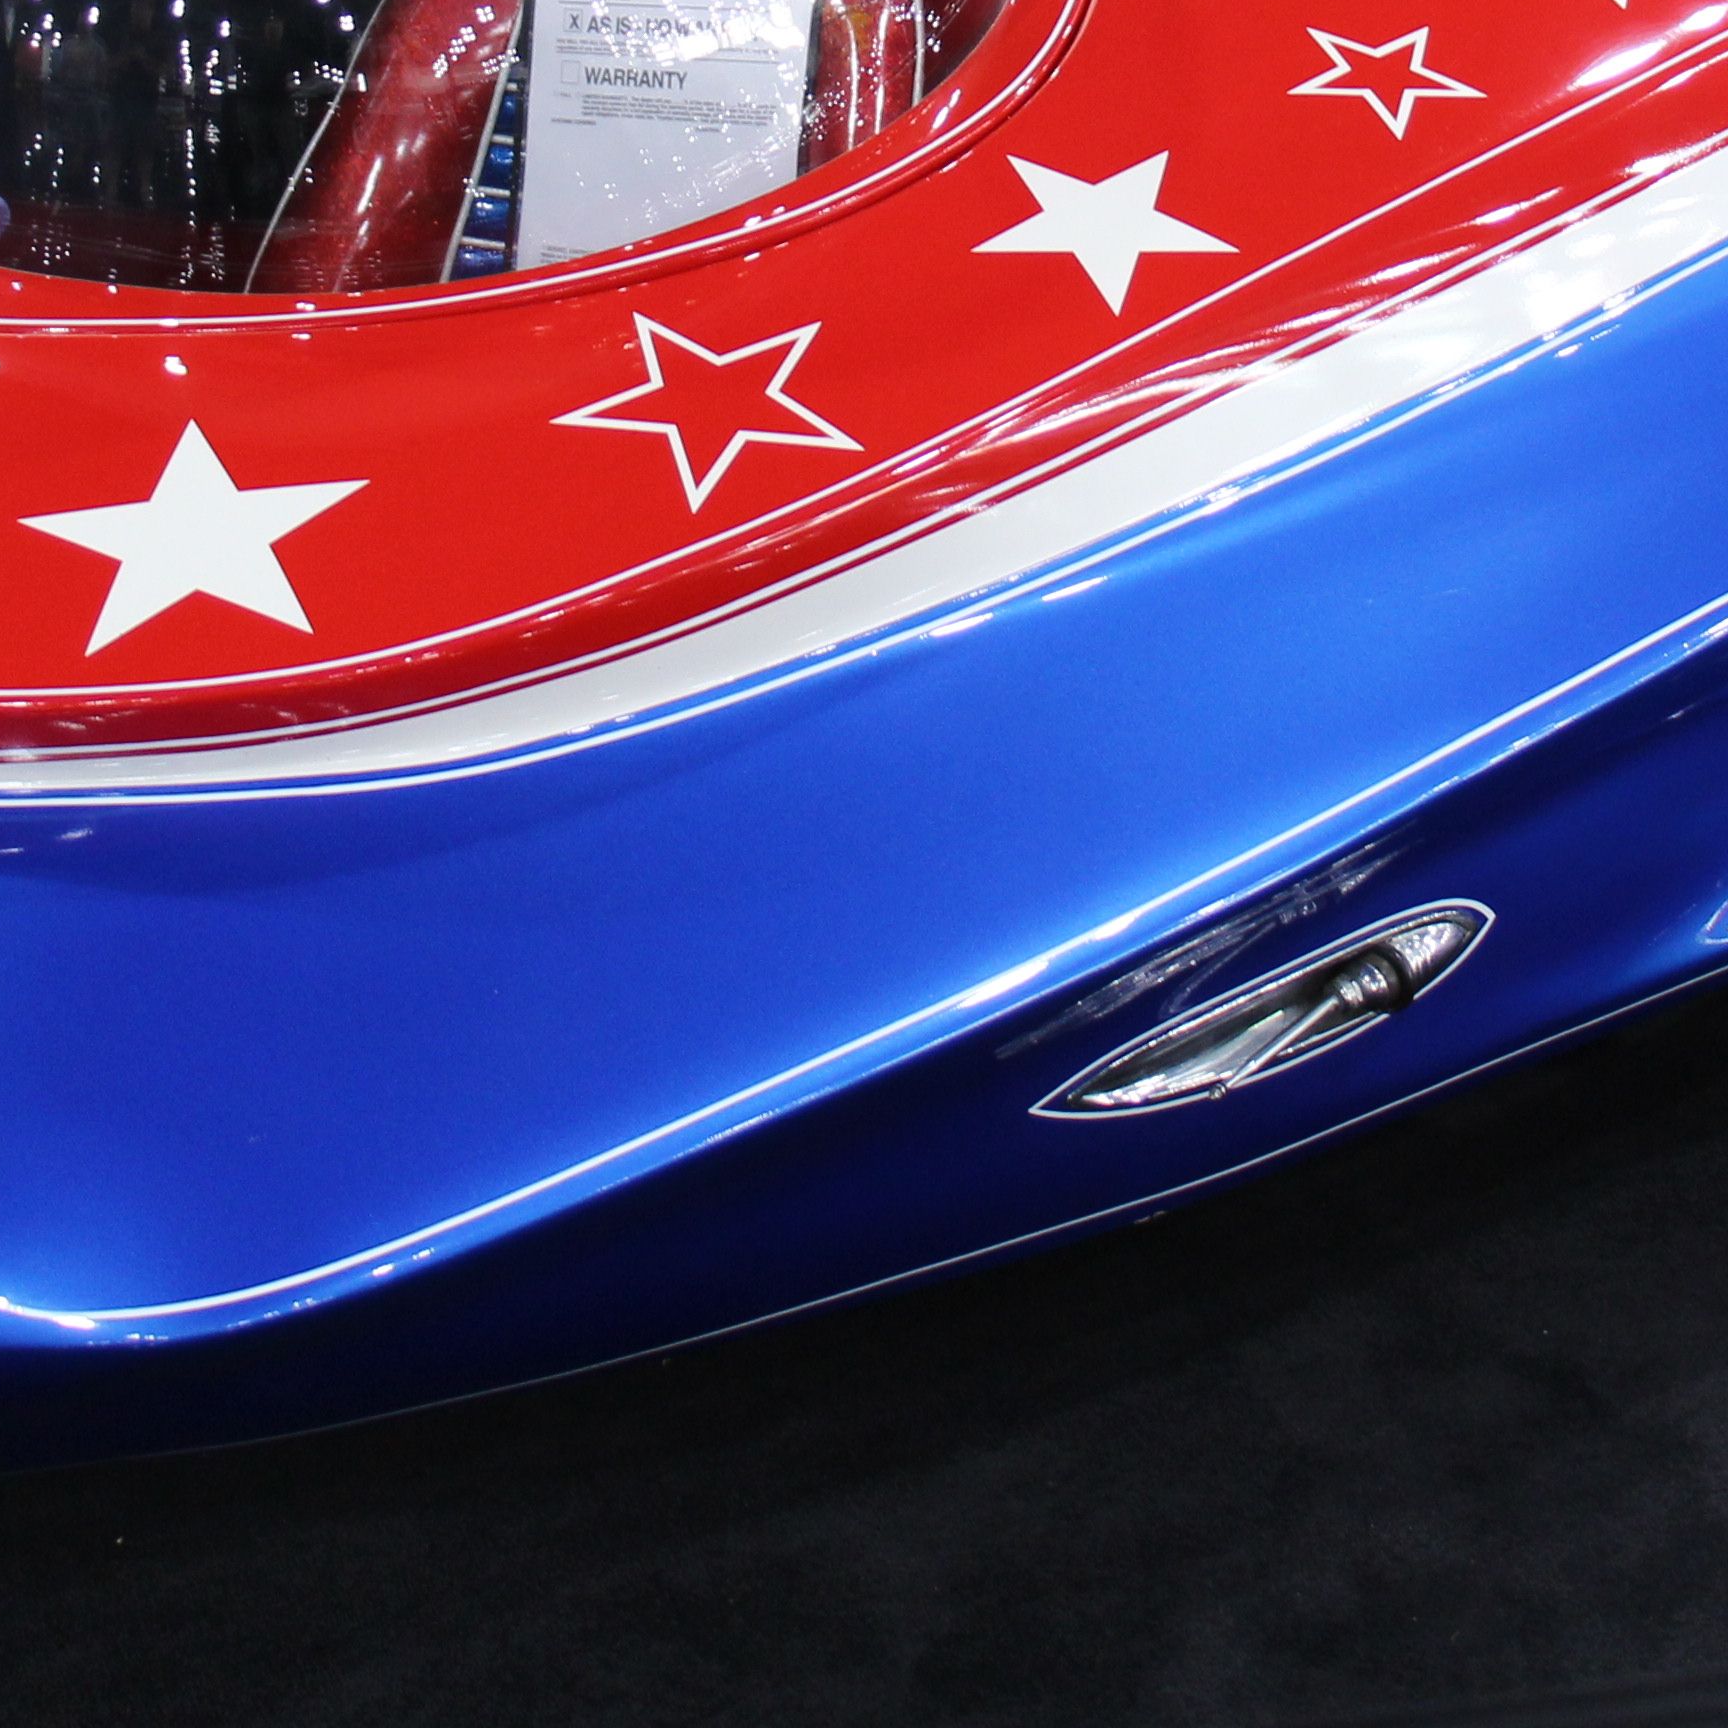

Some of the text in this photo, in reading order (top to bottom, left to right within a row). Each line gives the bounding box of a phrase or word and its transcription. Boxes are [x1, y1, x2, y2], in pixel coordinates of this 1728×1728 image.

[569, 13, 582, 30] X
[586, 15, 611, 35] AS
[615, 16, 633, 35] IS
[583, 65, 689, 91] WARRANTY
